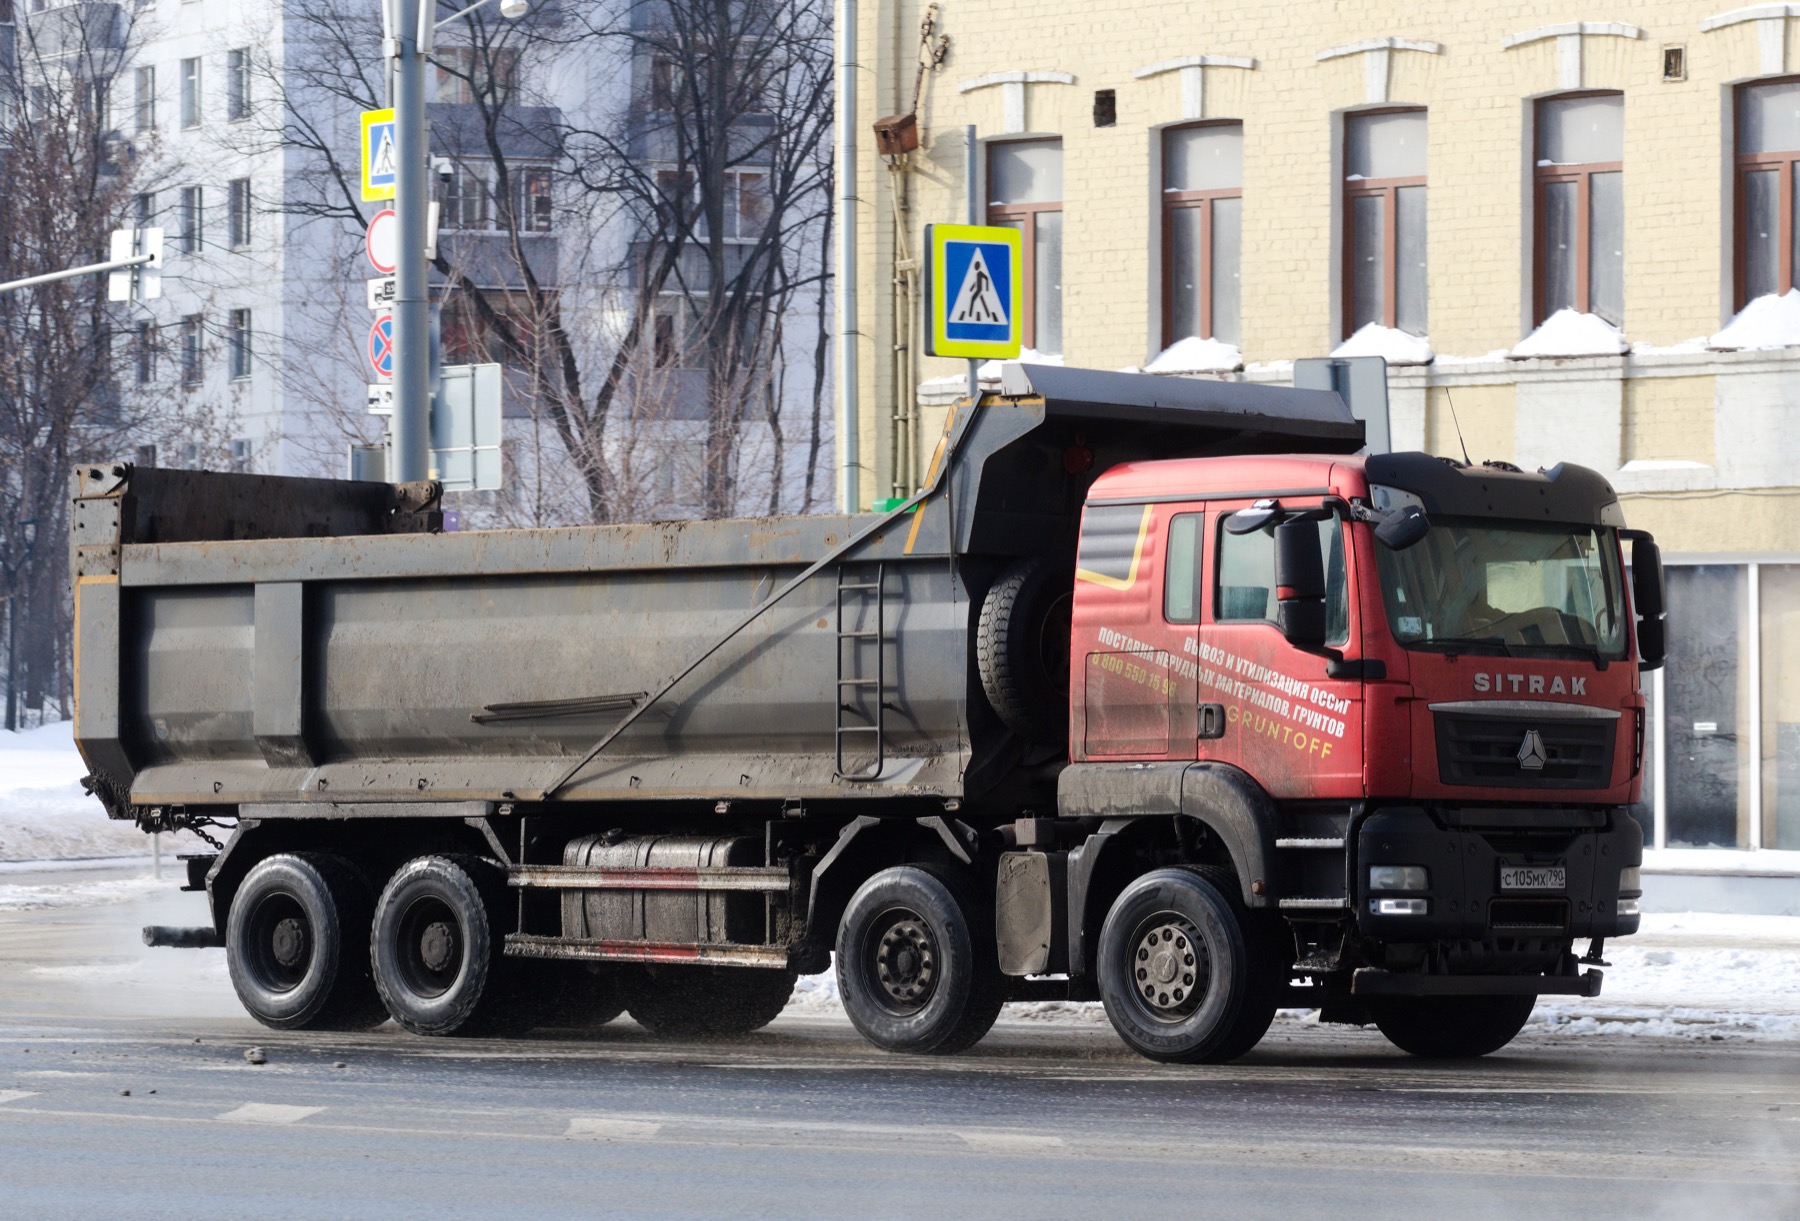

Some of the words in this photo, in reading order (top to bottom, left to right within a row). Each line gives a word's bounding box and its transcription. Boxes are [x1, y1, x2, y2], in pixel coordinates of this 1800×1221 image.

[1092, 649, 1100, 665] 8
[1101, 653, 1124, 676] 800
[1124, 662, 1147, 686] 550
[1148, 672, 1161, 691] 15
[1155, 651, 1216, 687] НЕРУДНЫХ
[1215, 673, 1291, 720] МАТЕРИАЛОВ,
[1292, 704, 1346, 739] ГРУНТОВ
[1184, 636, 1225, 666] ВЫВОЗ
[1225, 649, 1235, 670] И
[1235, 657, 1310, 700] УТИЛИЗАЦИЯ
[1473, 672, 1587, 696] SITRAK
[1226, 704, 1333, 759] GRUNTOFF
